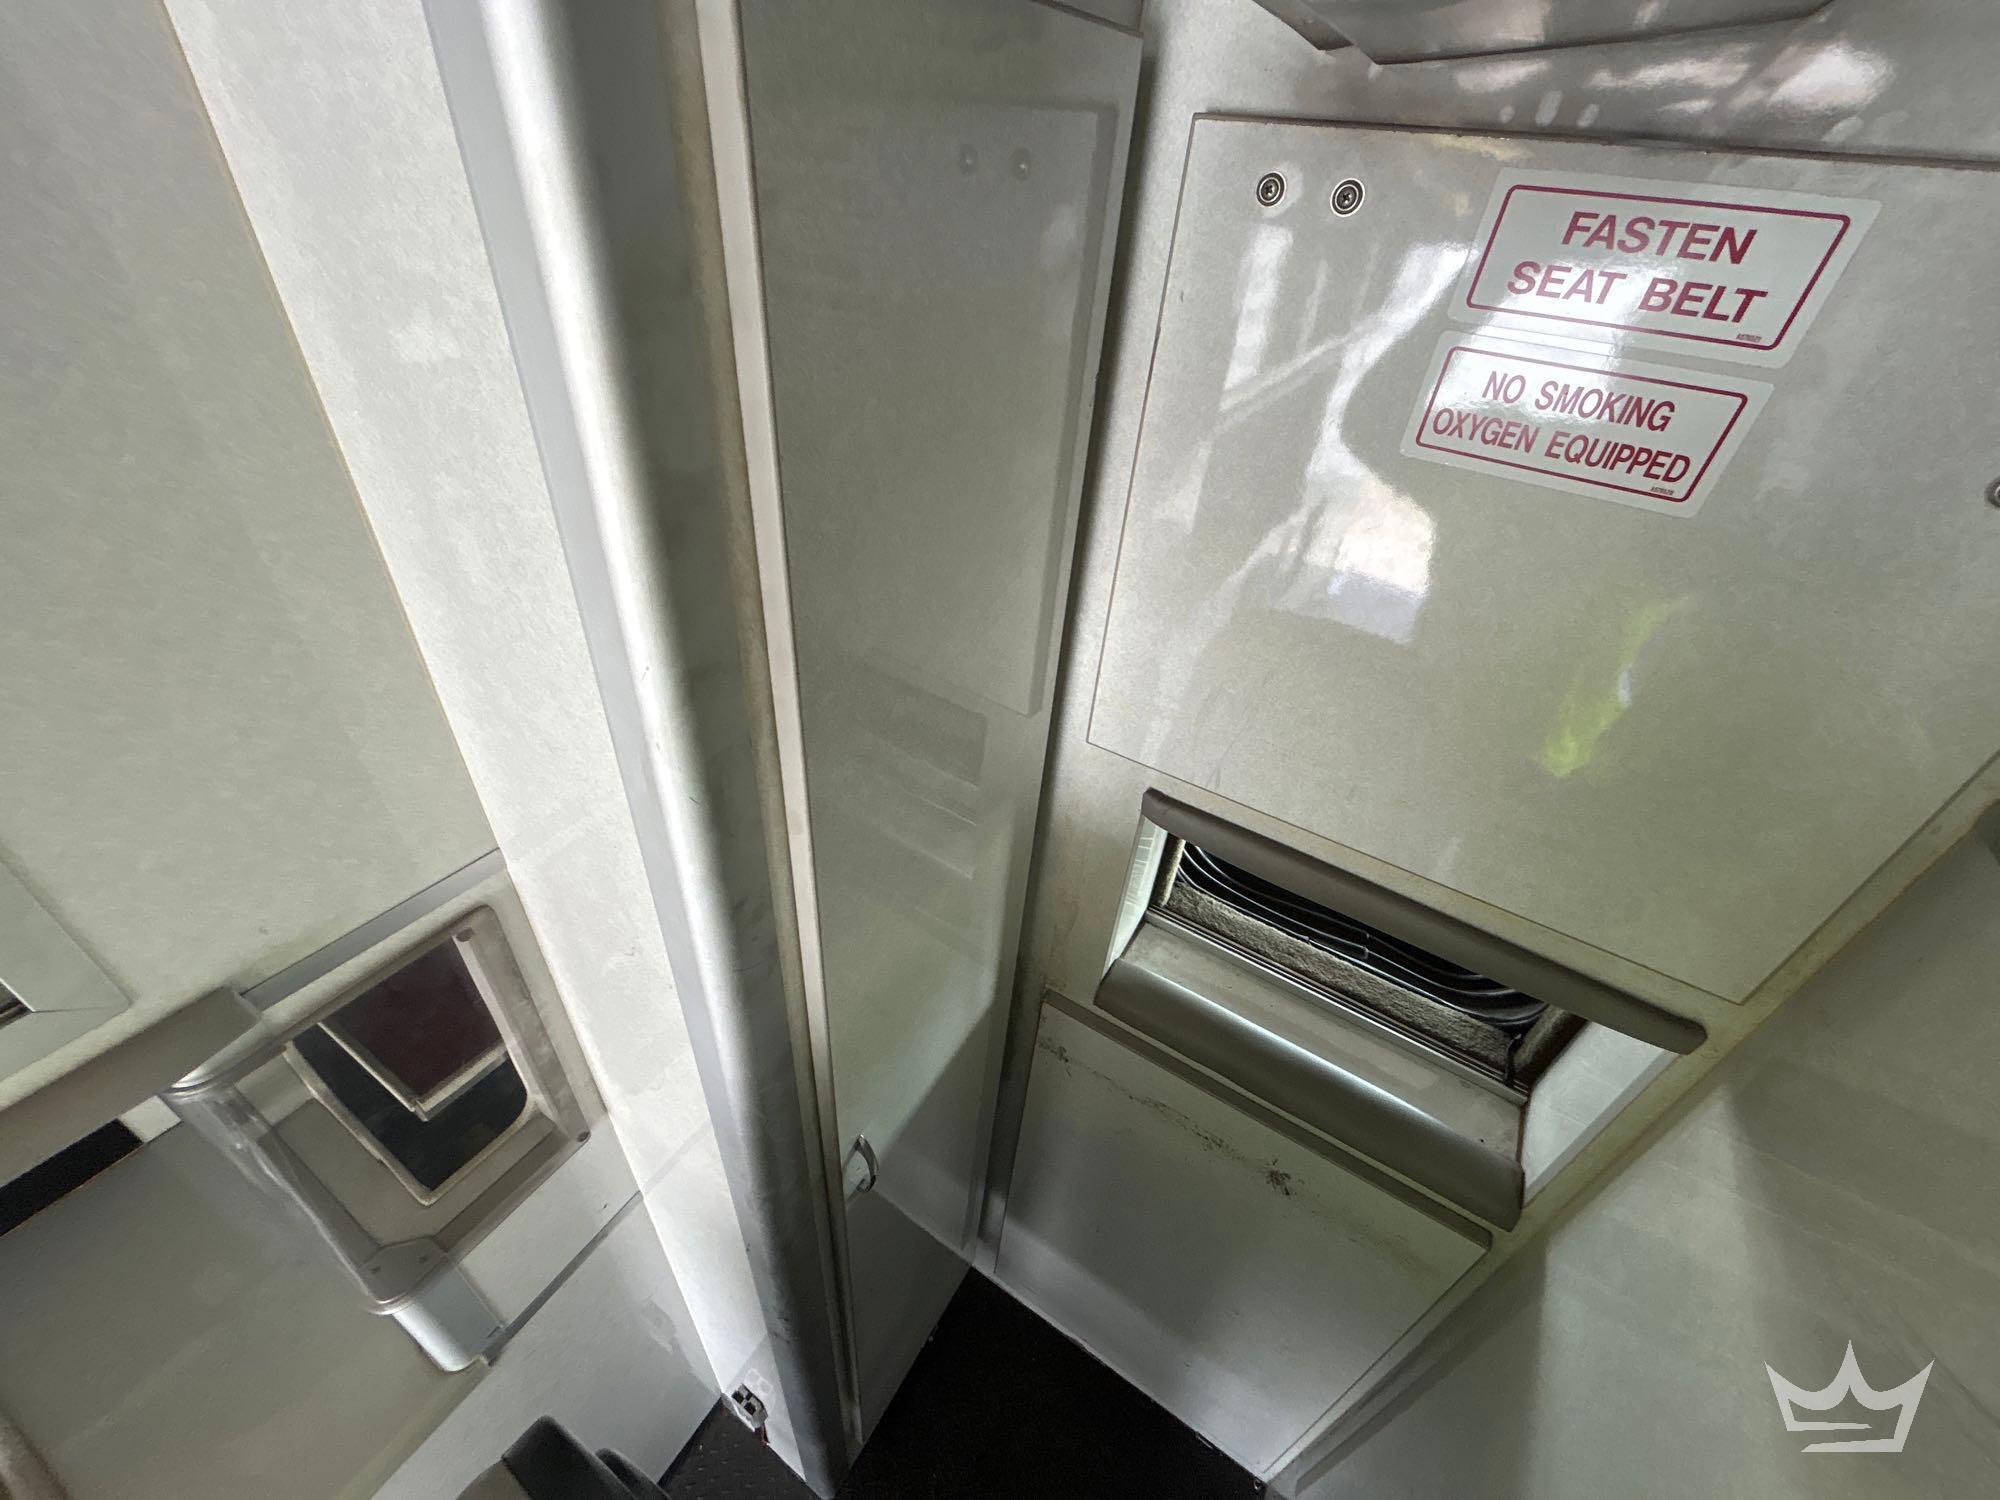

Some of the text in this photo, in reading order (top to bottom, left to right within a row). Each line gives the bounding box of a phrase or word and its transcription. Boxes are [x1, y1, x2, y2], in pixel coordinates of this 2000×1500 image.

[1561, 211, 1757, 264] FASTEN
[1507, 261, 1768, 324] SEAT BELT
[1482, 370, 1675, 432] NO SMOKING
[1432, 409, 1690, 483] OXYGEN EQUIPPED
